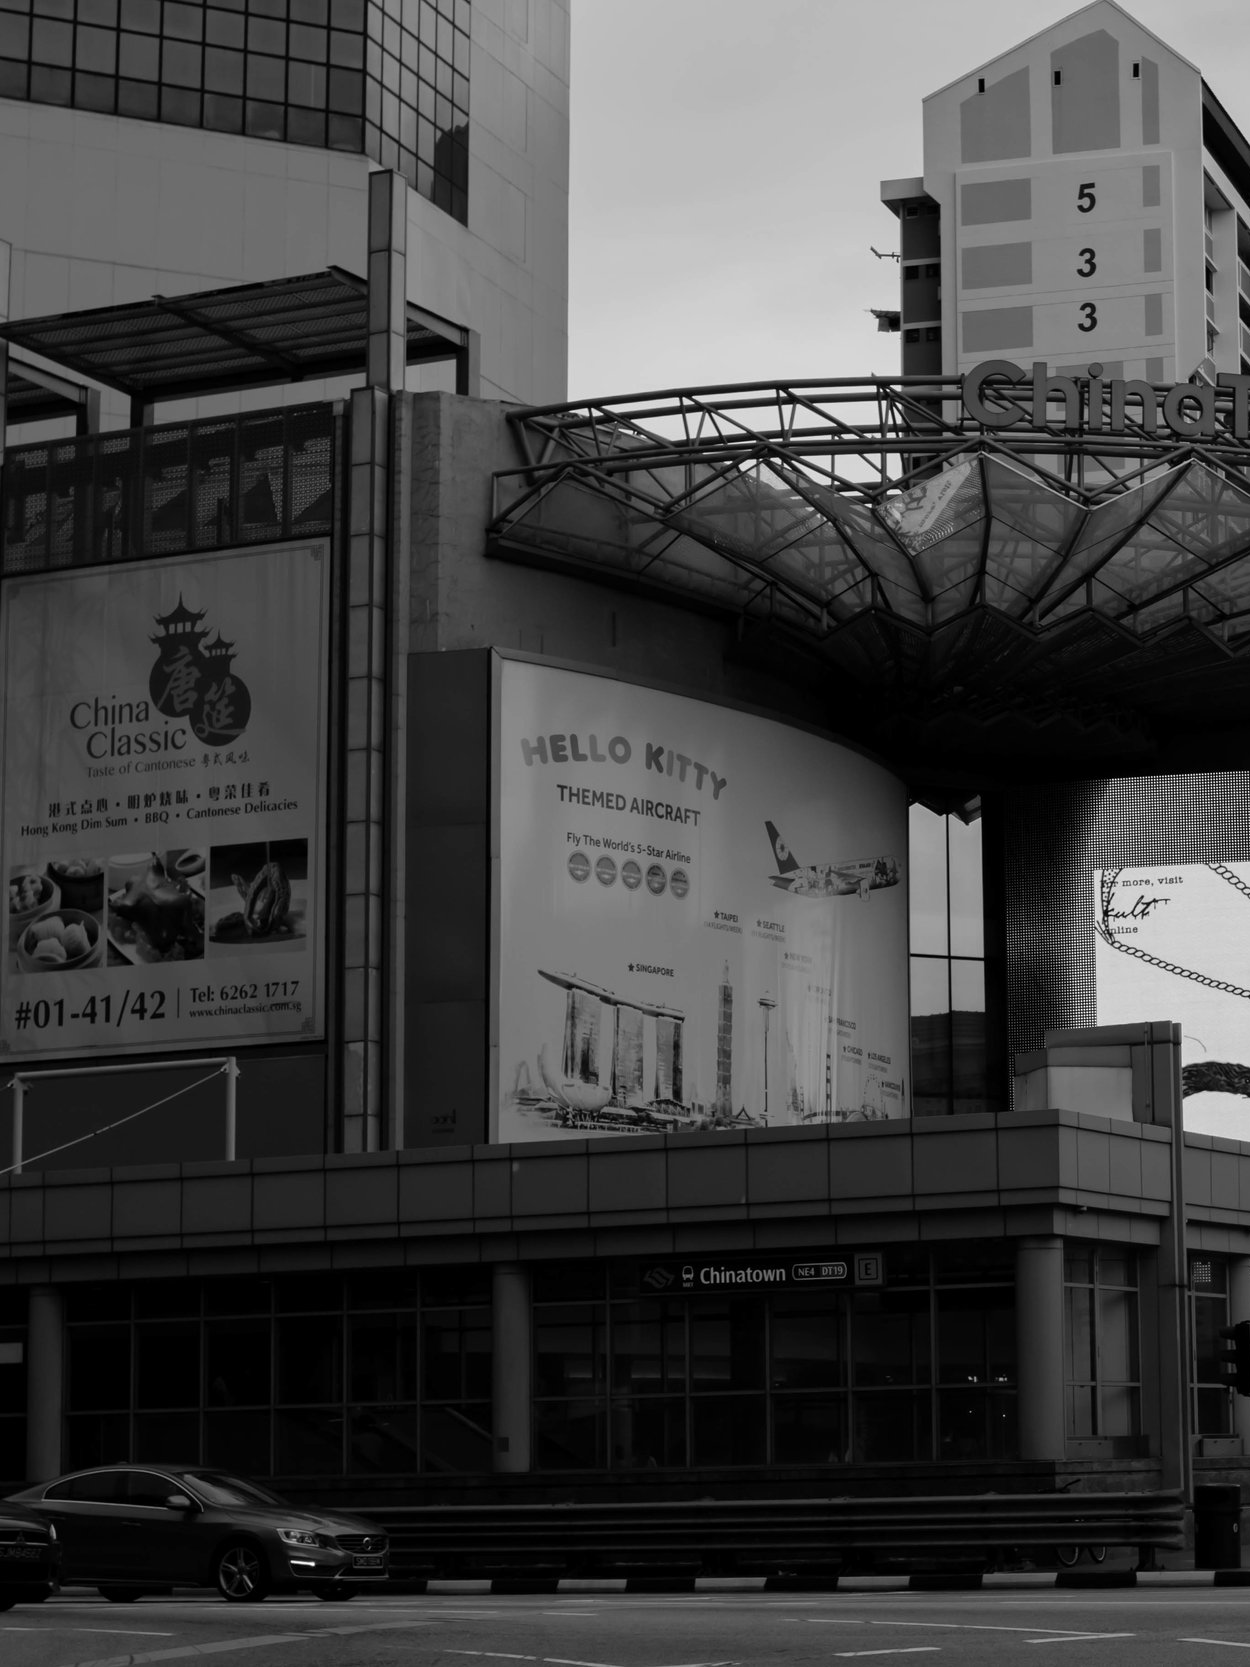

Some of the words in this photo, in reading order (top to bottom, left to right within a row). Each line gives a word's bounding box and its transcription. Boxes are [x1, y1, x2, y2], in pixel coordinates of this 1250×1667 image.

[1077, 182, 1096, 213] 5
[1076, 248, 1097, 278] 3
[1077, 302, 1098, 332] 3
[70, 695, 149, 730] China
[86, 720, 187, 759] Classic
[87, 765, 115, 778] Taste
[119, 761, 132, 775] of
[135, 758, 196, 773] Cantonese
[521, 734, 632, 767] HELLO
[645, 742, 727, 800] KITTY
[21, 824, 49, 837] Hong
[51, 821, 78, 835] Kong
[81, 818, 102, 830] Dim
[105, 816, 128, 828] Sum
[145, 811, 169, 823] BBQ
[186, 805, 241, 819] Cantonese
[244, 799, 298, 814] Delicacies
[556, 784, 626, 811] THEMED
[630, 797, 701, 826] AIRCRAFT
[566, 832, 581, 846] Fly
[583, 834, 601, 848] The
[602, 837, 635, 853] World's
[636, 844, 664, 858] 5-Star
[665, 849, 691, 864] Airline
[1122, 879, 1154, 887] more,
[1157, 876, 1184, 884] visit
[720, 911, 739, 923] TAIPEI
[762, 920, 785, 933] SEATTLE
[1106, 926, 1139, 935] nline
[635, 963, 674, 977] SINGAPORE
[190, 986, 215, 1003] Tel:
[220, 983, 258, 1002] 6262
[265, 980, 300, 998] 1717
[15, 990, 166, 1030] #01-41/42
[700, 1266, 786, 1284] Chinatown
[798, 1267, 815, 1277] NE4
[822, 1265, 843, 1276] DT19
